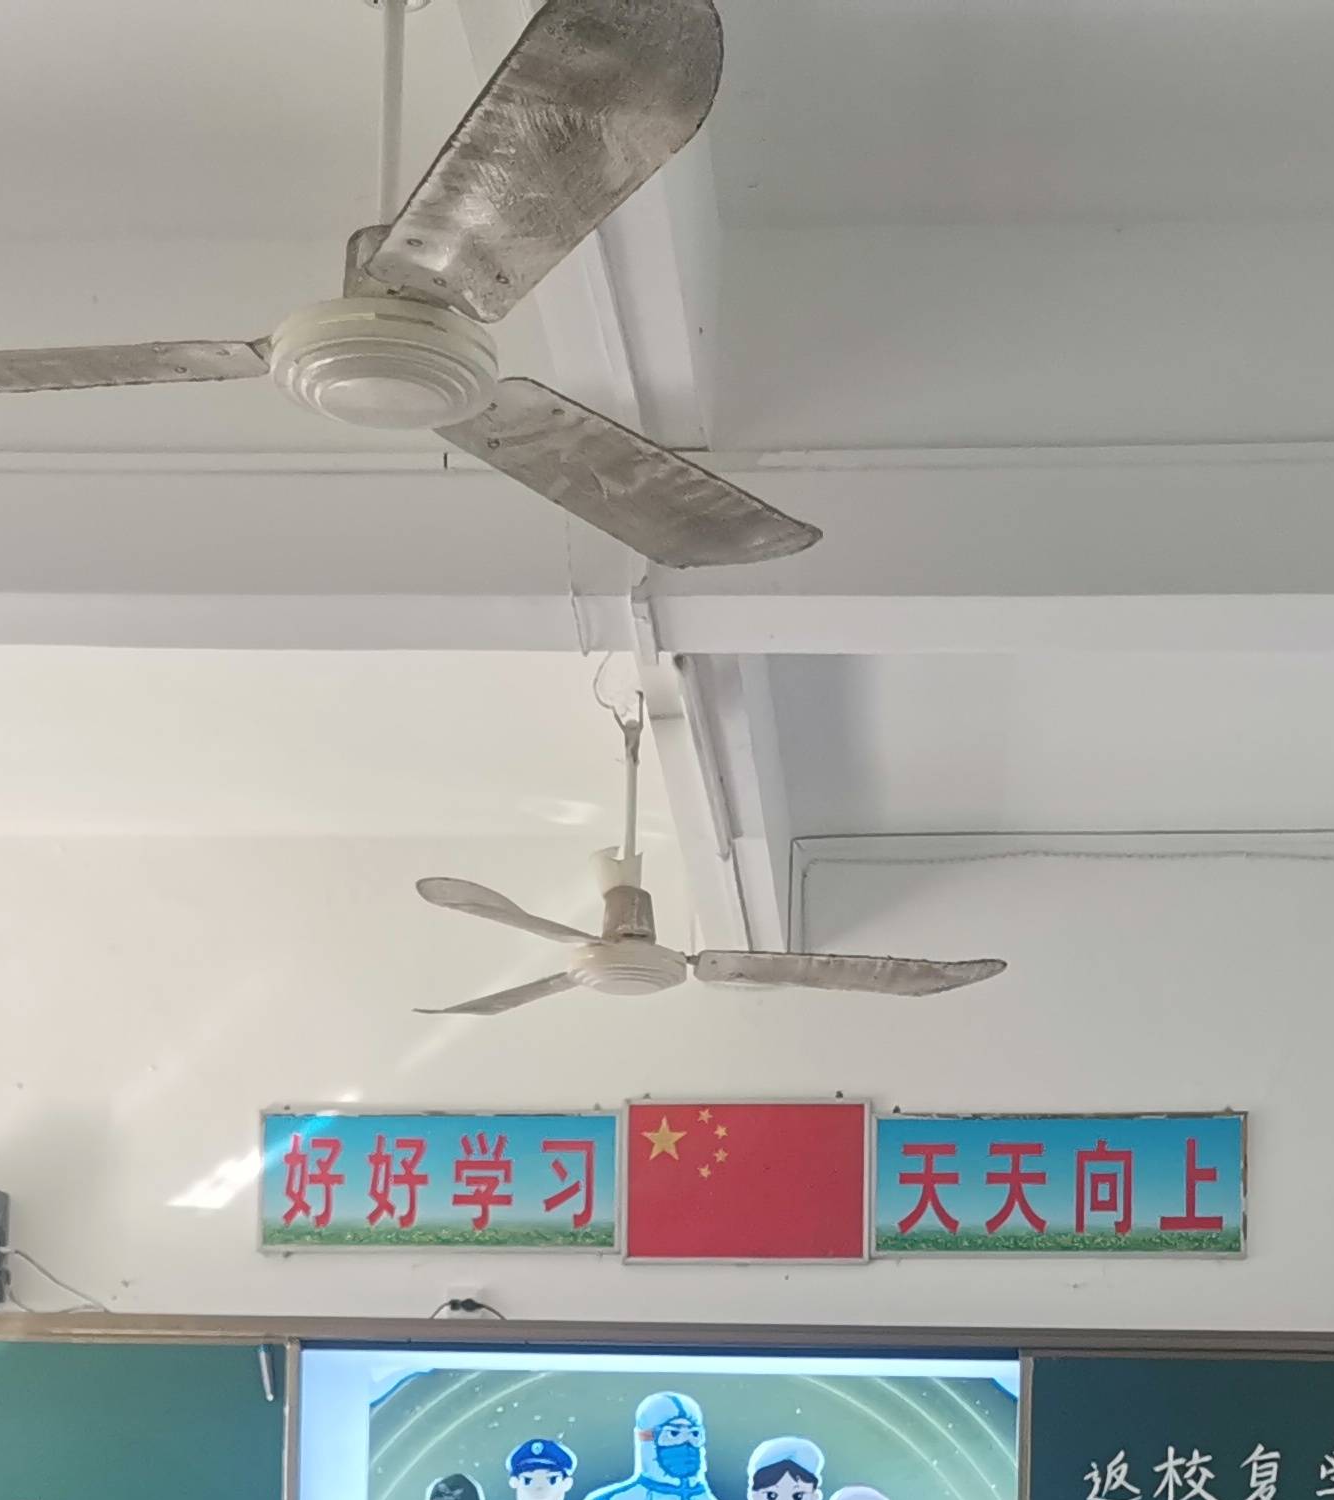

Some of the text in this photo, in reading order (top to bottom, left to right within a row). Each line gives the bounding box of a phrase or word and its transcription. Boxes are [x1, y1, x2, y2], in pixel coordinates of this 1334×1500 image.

[281, 1131, 598, 1233] 好好学习
[897, 1137, 1226, 1235] 天天向上
